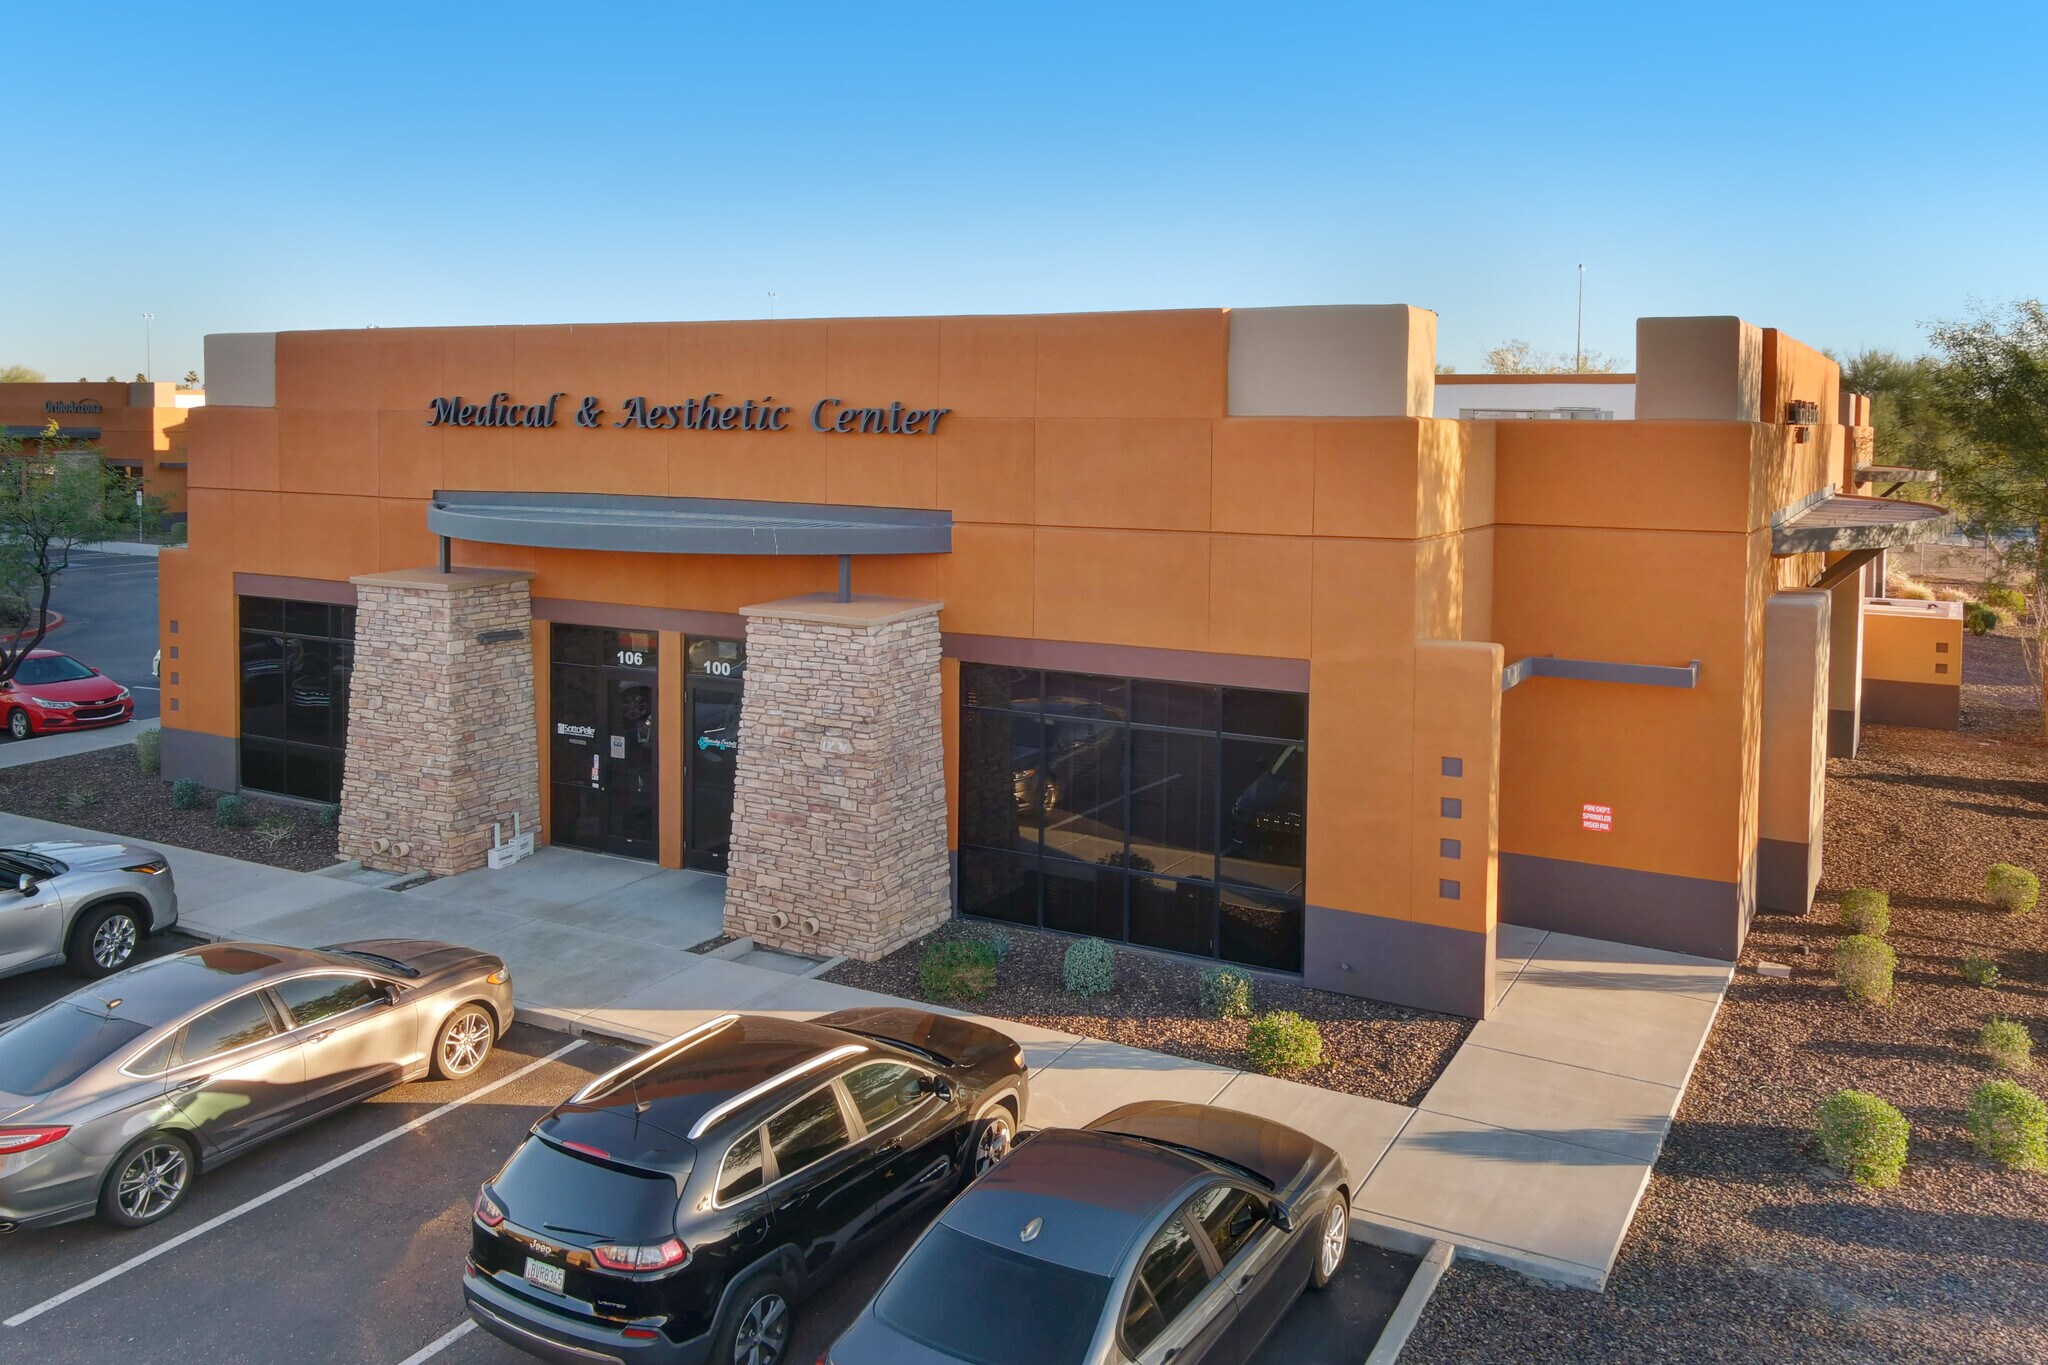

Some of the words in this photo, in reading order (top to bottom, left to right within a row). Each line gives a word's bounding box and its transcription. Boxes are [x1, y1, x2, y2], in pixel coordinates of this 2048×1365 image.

[44, 400, 102, 414] OrthoArizona
[425, 392, 566, 428] Medical
[575, 396, 605, 429] &
[613, 392, 792, 431] Aesthetic
[810, 398, 953, 436] Center
[616, 650, 643, 666] 106
[703, 660, 731, 677] 100
[1584, 804, 1596, 812] FIRE
[1582, 812, 1611, 822] SPRINKLER
[1583, 821, 1599, 829] RISER
[530, 1239, 552, 1257] Jeep
